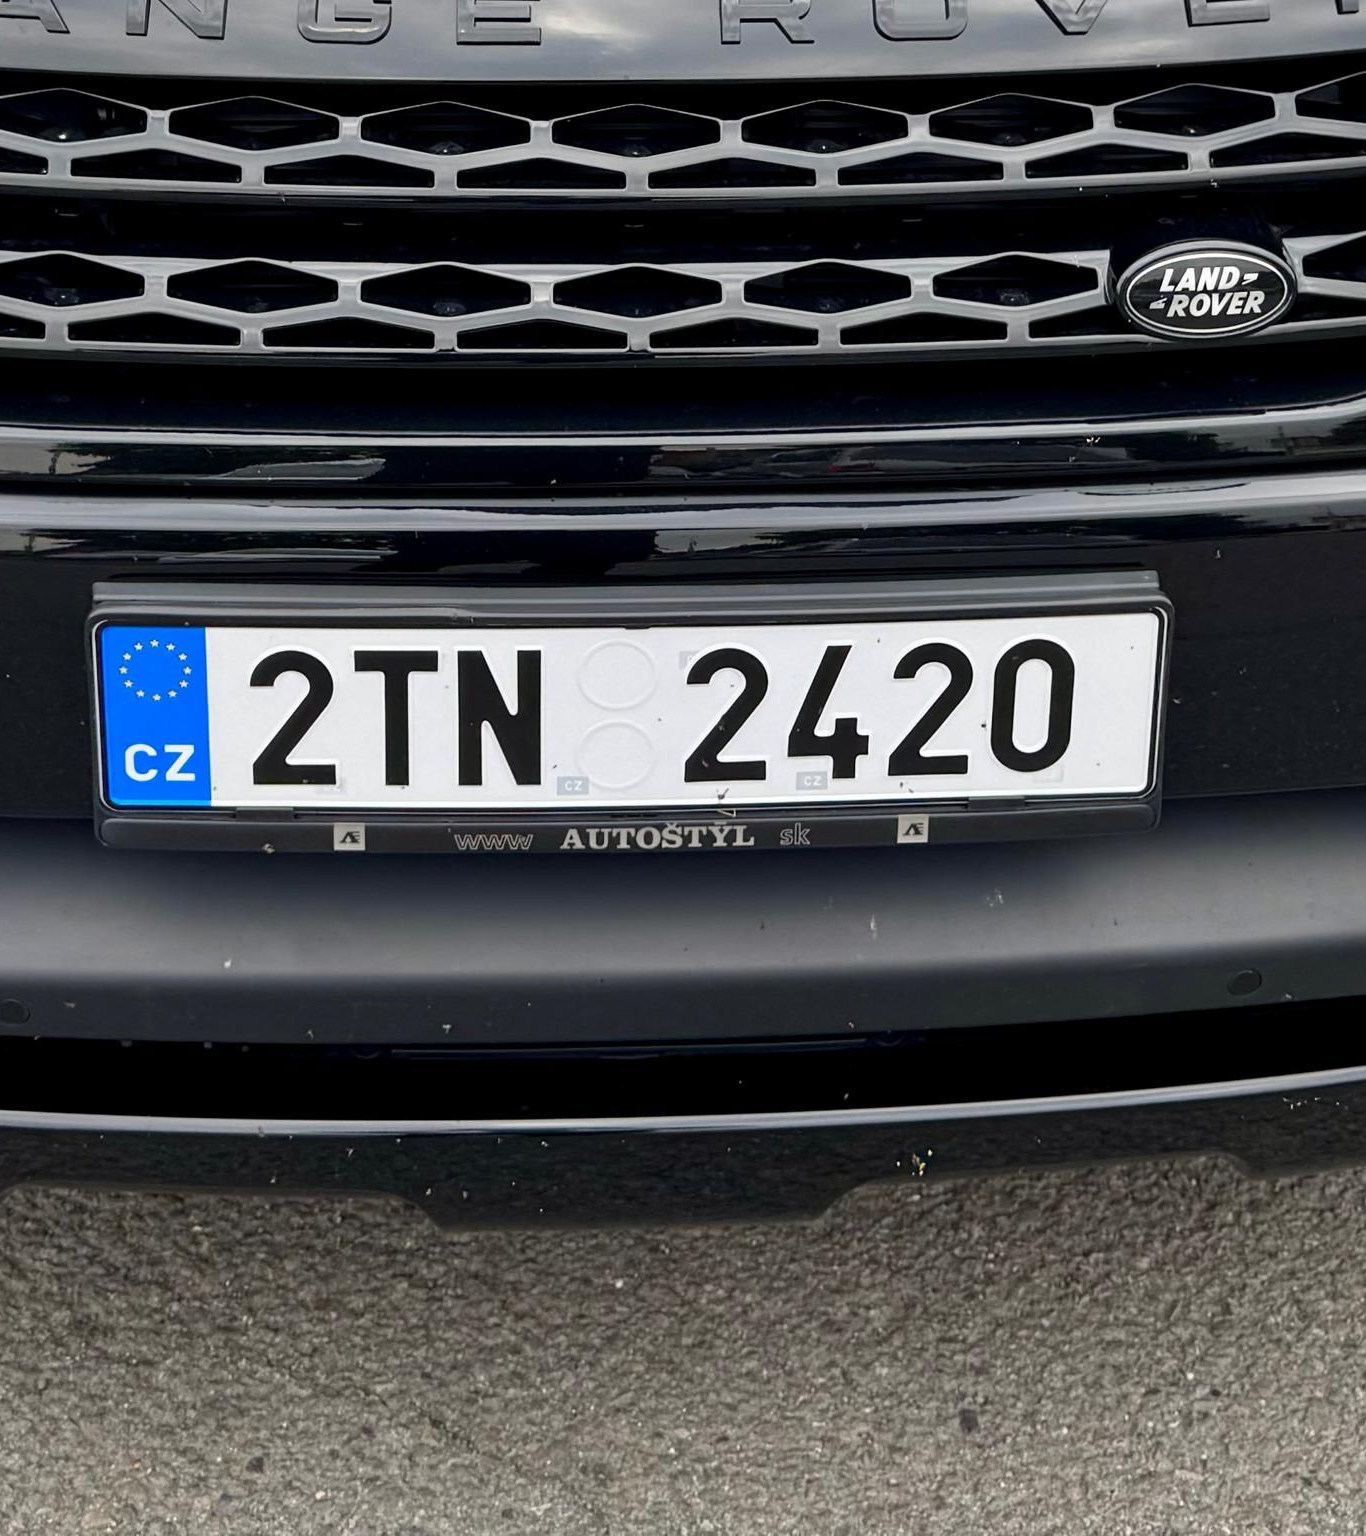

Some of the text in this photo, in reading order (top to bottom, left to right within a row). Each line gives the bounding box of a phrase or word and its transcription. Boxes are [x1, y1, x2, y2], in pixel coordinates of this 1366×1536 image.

[1159, 265, 1240, 292] LAND
[1166, 290, 1266, 317] ROVER
[249, 638, 1076, 787] 2TN 2420
[124, 743, 196, 782] CZ
[454, 833, 534, 850] www
[779, 822, 811, 846] sk
